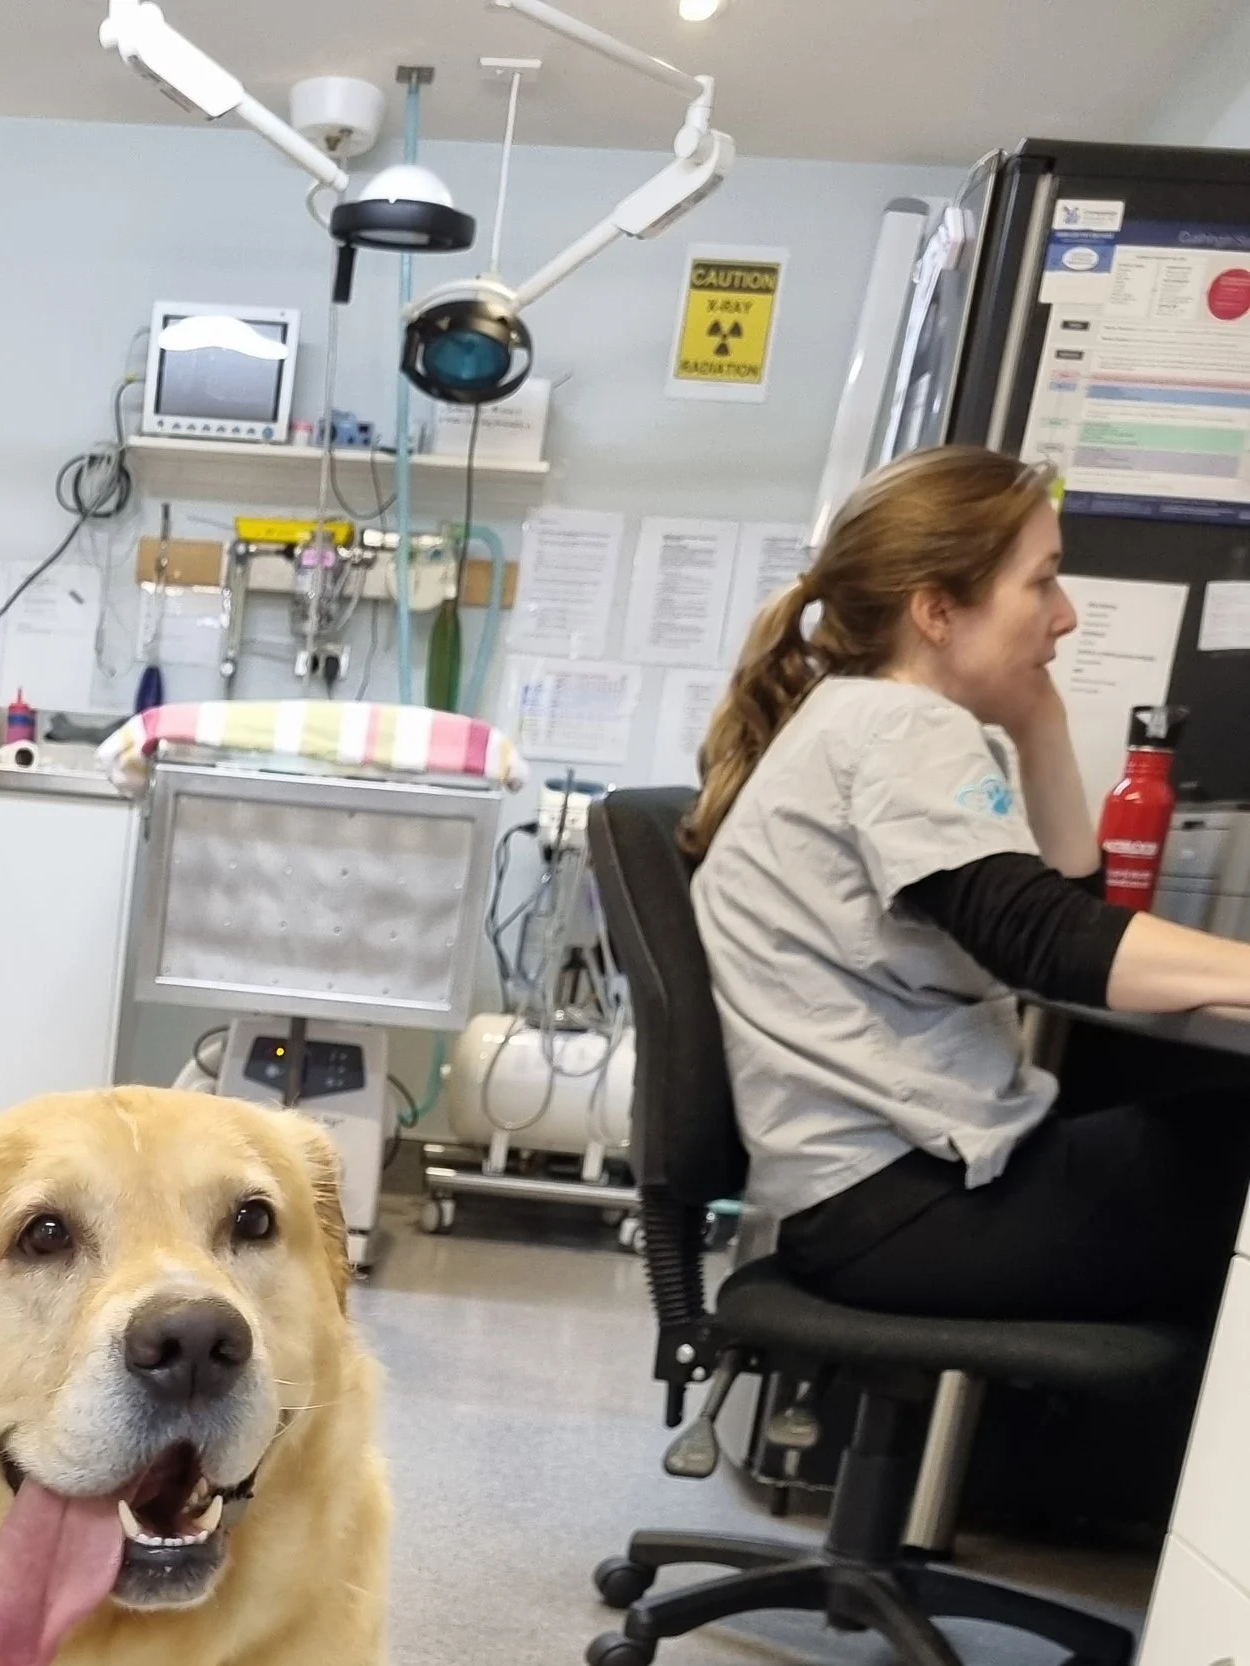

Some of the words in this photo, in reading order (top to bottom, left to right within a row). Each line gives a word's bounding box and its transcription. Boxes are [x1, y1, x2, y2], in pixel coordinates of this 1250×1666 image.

[691, 268, 776, 291] CAUTION
[706, 298, 754, 314] X-RAY
[679, 358, 759, 378] RADIATION
